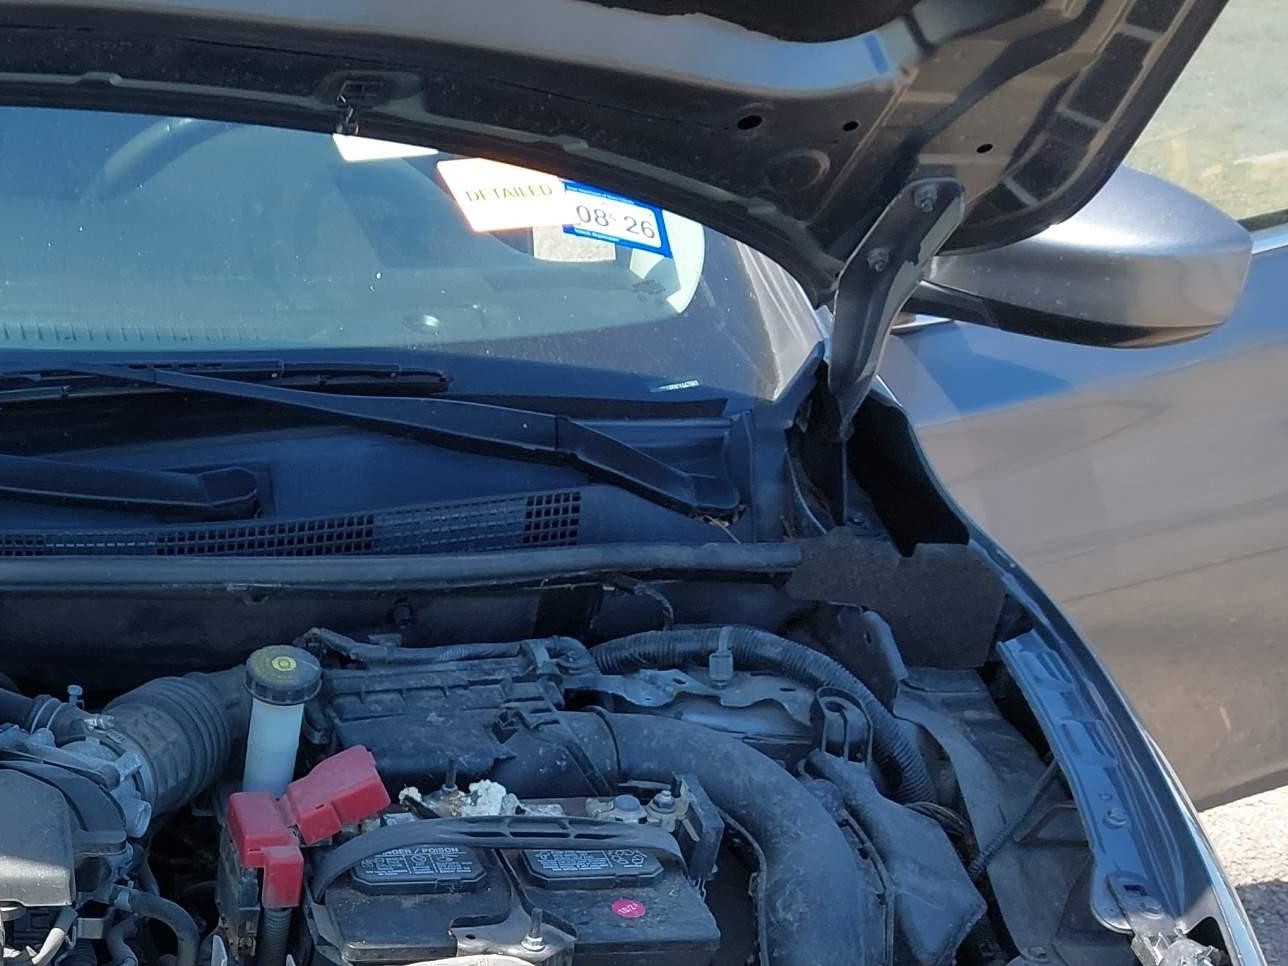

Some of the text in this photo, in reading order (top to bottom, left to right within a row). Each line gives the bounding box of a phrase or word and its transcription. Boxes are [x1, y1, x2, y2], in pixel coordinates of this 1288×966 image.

[465, 184, 553, 202] DETAILED
[576, 204, 610, 227] 08
[623, 215, 656, 239] 26
